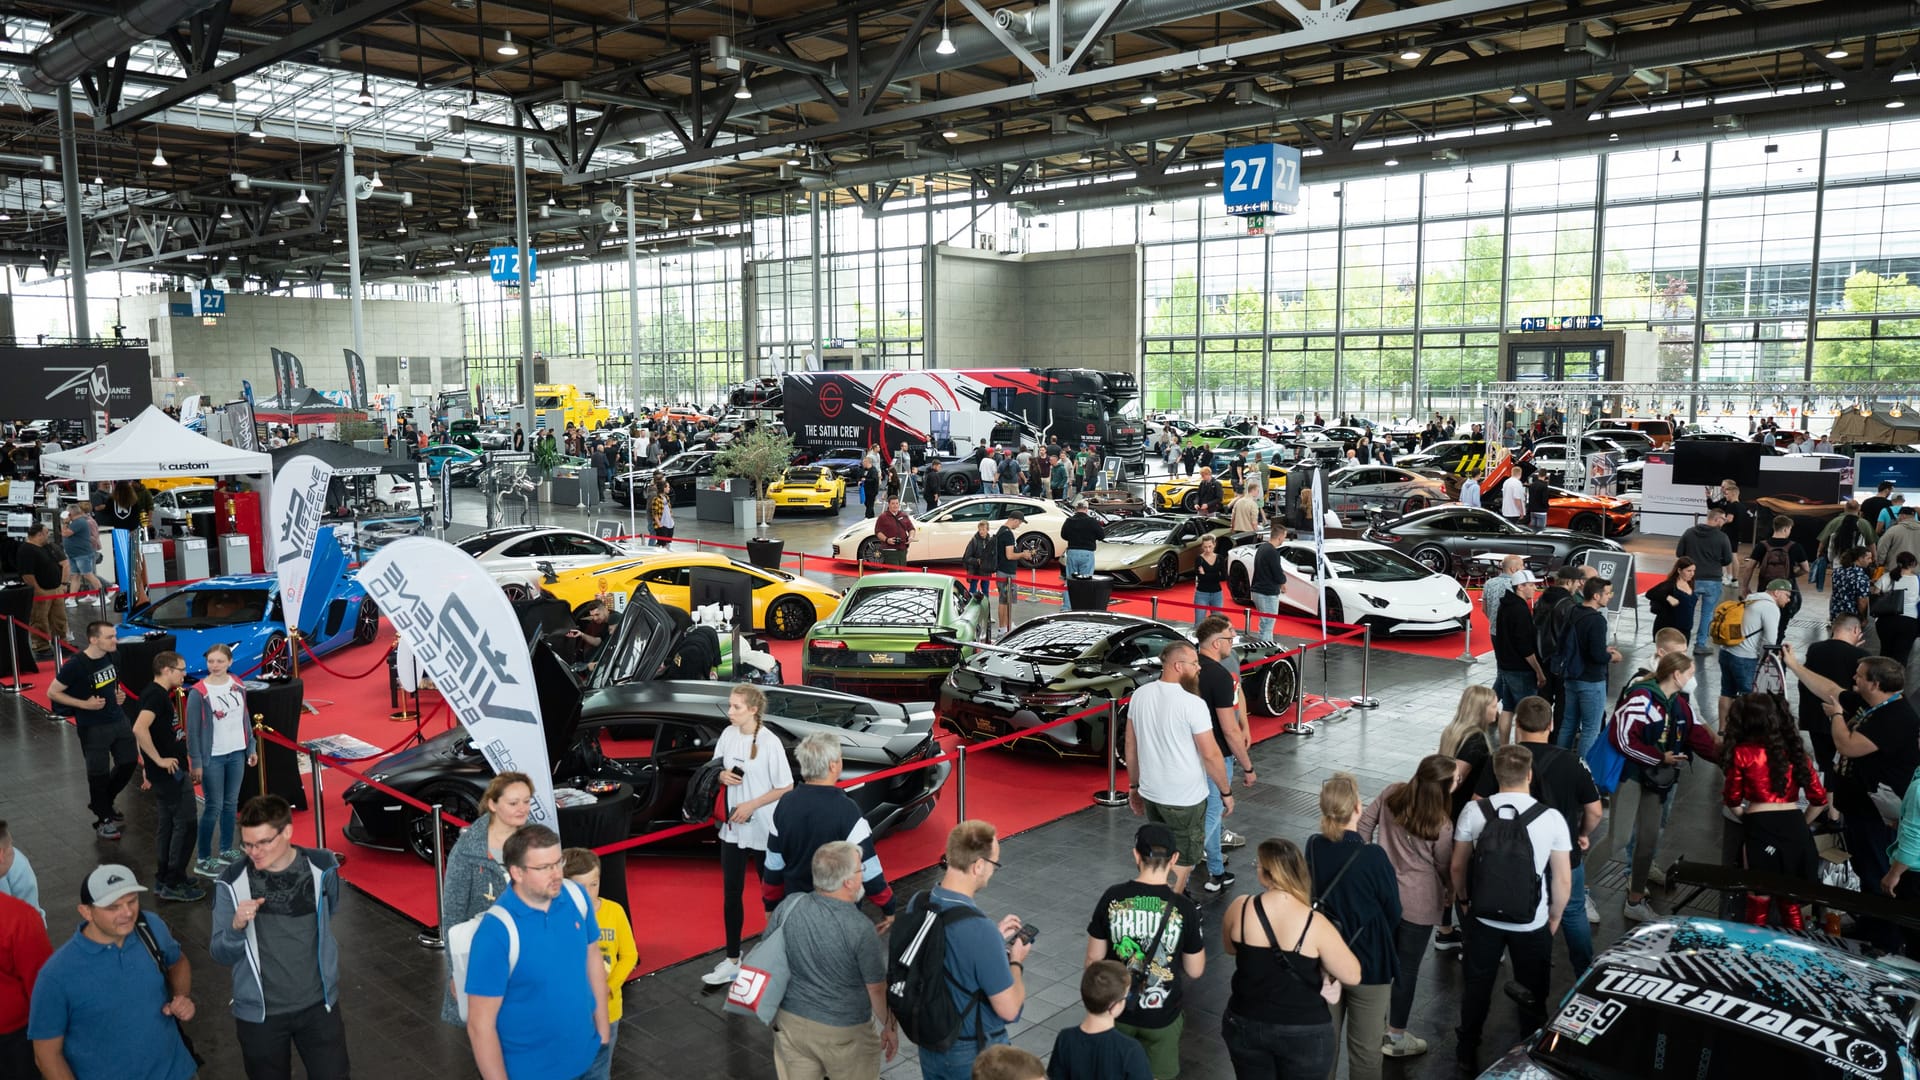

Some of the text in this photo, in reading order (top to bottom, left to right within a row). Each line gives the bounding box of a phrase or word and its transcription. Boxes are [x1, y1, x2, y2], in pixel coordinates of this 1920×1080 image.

[1230, 157, 1266, 192] 27
[1275, 157, 1297, 192] 27
[492, 255, 506, 274] 27
[203, 294, 222, 308] 27
[1536, 319, 1545, 328] 13
[805, 425, 860, 439] THE SATIN CREW
[168, 461, 209, 471] custom
[299, 465, 322, 530] SZENE
[303, 471, 330, 560] BIELEFELD
[1601, 563, 1613, 575] PS
[599, 928, 615, 941] STER
[1109, 908, 1183, 953] KRAUS
[1595, 969, 1849, 1056] TIME ATTACK
